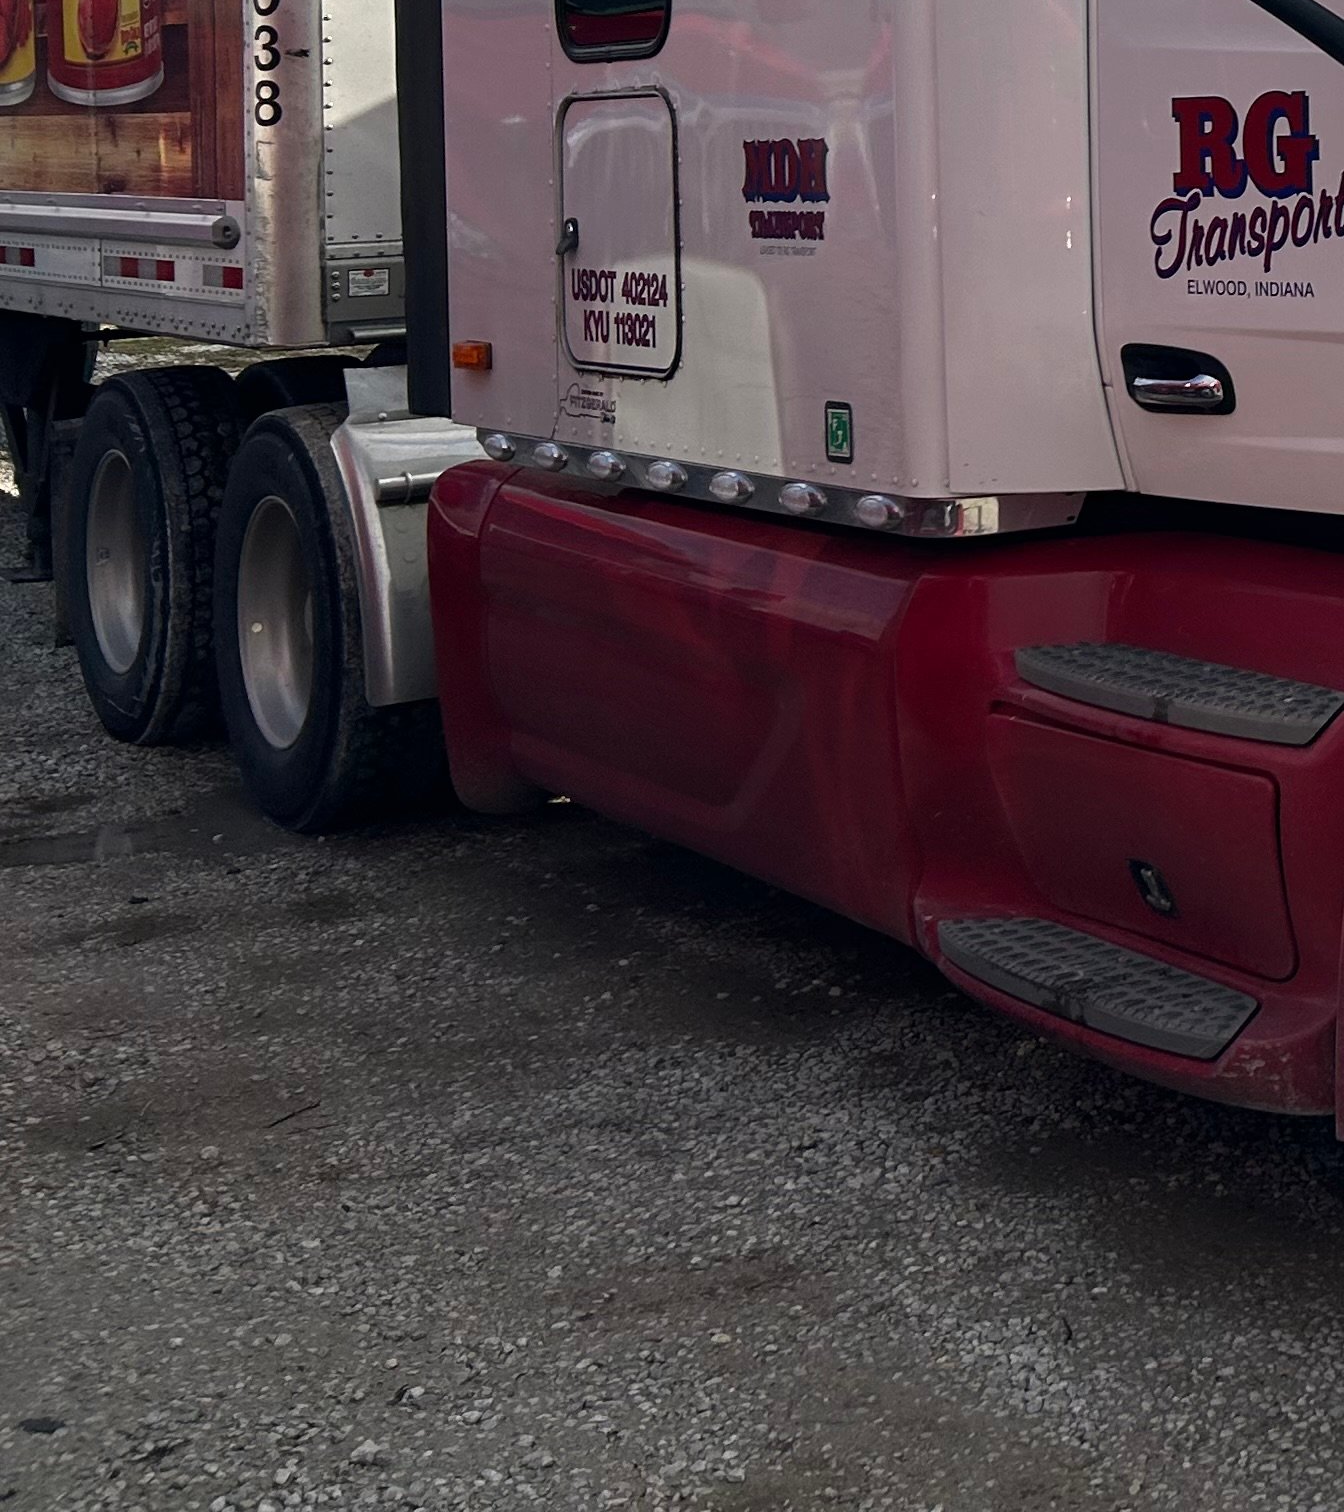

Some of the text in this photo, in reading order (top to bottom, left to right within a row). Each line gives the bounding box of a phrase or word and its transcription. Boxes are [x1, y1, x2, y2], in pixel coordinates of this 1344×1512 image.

[1171, 90, 1320, 199] RG
[572, 268, 668, 308] USDOT 402124
[1187, 279, 1315, 298] ELWOOD, INDIANA
[583, 309, 609, 344] KYU
